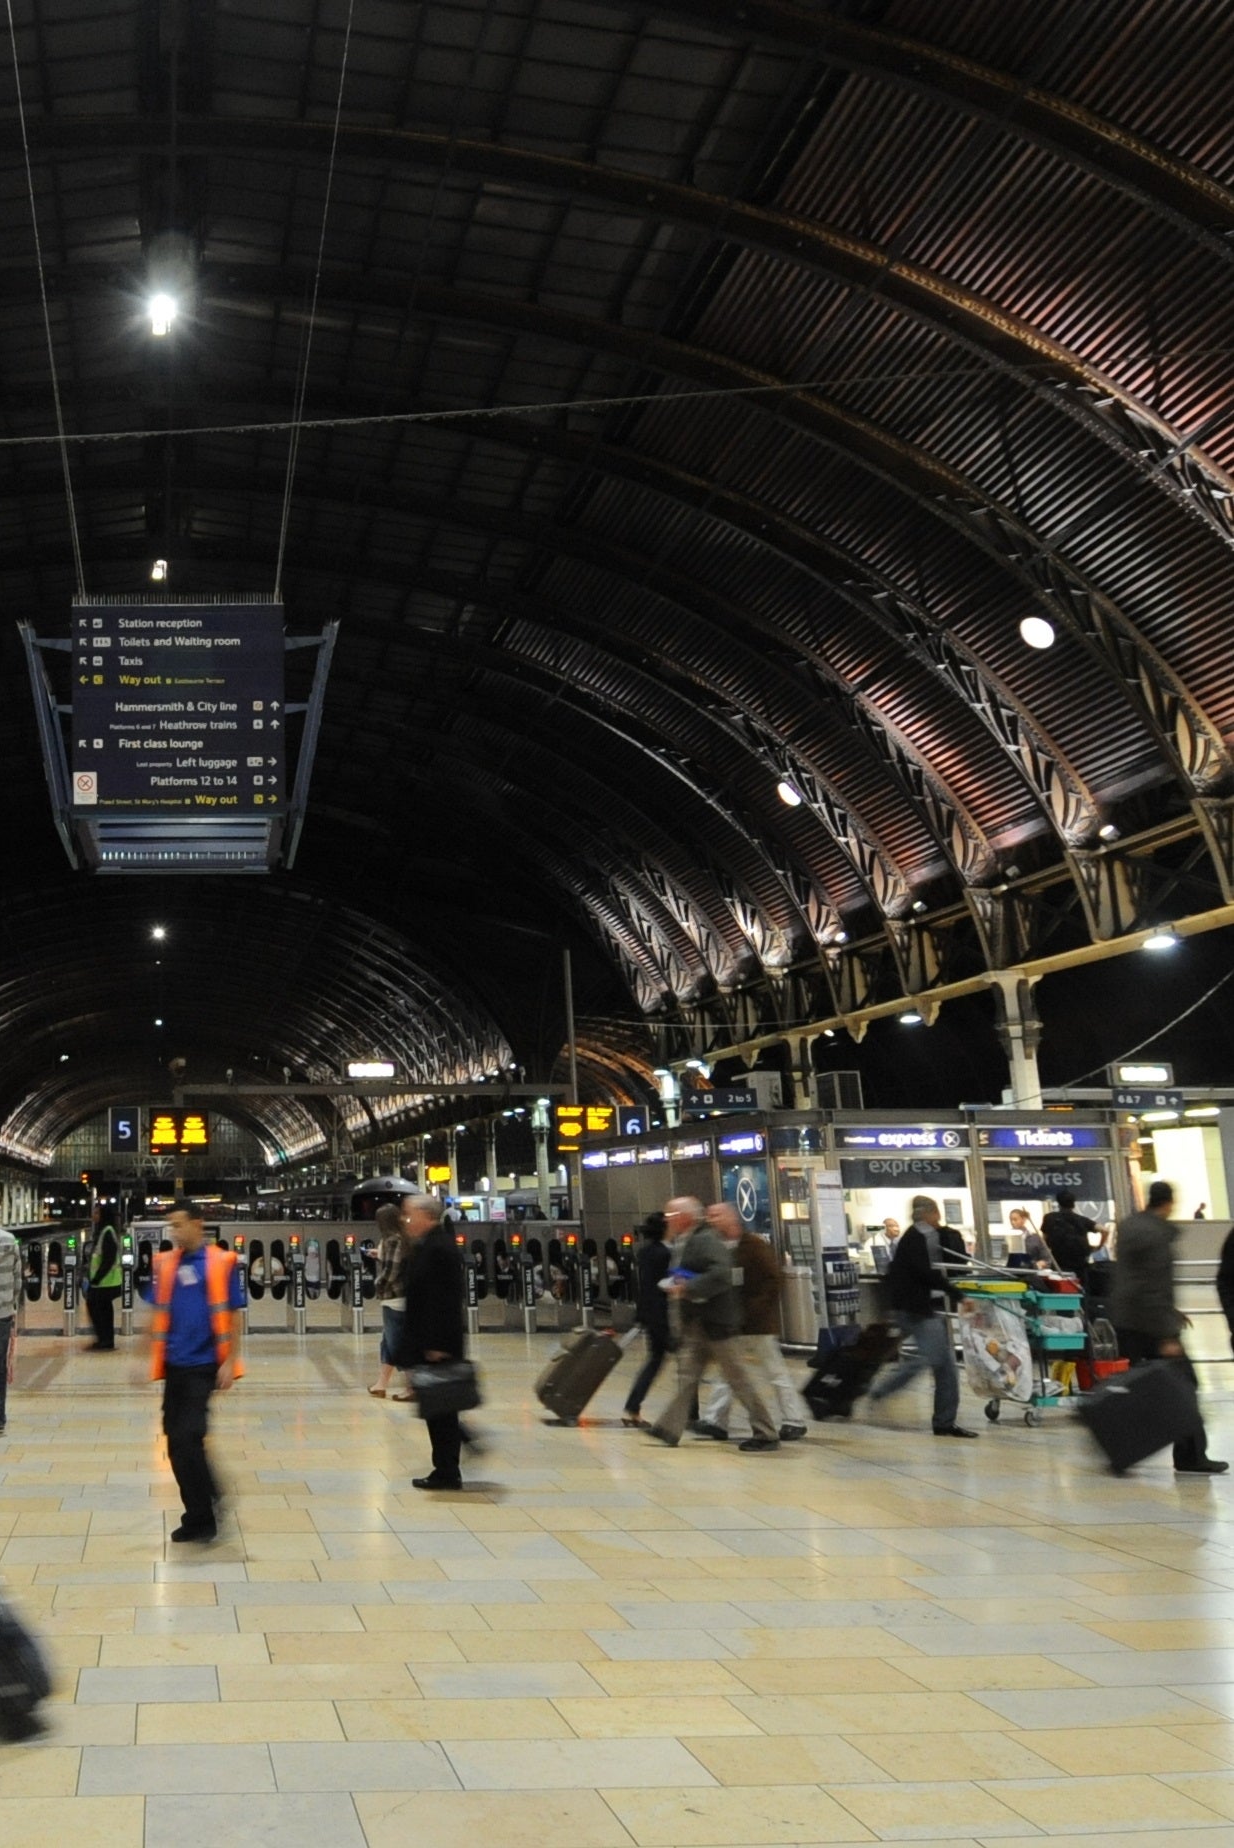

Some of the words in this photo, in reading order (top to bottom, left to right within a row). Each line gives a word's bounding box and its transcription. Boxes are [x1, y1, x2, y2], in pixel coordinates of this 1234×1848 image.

[118, 618, 154, 628] Station
[156, 618, 202, 630] reception
[119, 636, 150, 647] Toilets
[154, 636, 172, 646] and
[174, 636, 212, 648] Waiting
[214, 638, 241, 646] room
[119, 656, 144, 666] Taxis
[119, 675, 142, 686] Way
[144, 676, 162, 685] out
[115, 701, 184, 712] Hammersmith
[186, 702, 195, 712] &
[197, 700, 218, 713] City
[220, 700, 238, 711] line
[160, 720, 207, 730] Heathrow
[210, 720, 238, 730] trains
[118, 738, 142, 748] First
[144, 738, 168, 748] class
[170, 738, 204, 750] lounge
[176, 757, 196, 768] Left
[198, 757, 238, 770] luggage
[150, 776, 198, 786] Platforms
[201, 776, 210, 786] 12
[213, 776, 224, 786] to
[227, 776, 238, 785] 14
[195, 795, 218, 806] Way
[220, 795, 238, 804] out
[728, 1094, 734, 1102] 2
[736, 1094, 745, 1102] to
[746, 1094, 752, 1102] 5
[118, 1120, 132, 1140] 5
[626, 1118, 641, 1135] 6
[878, 1132, 937, 1148] express
[1014, 1129, 1074, 1146] Tickets
[868, 1159, 942, 1176] express
[1010, 1171, 1082, 1189] express
